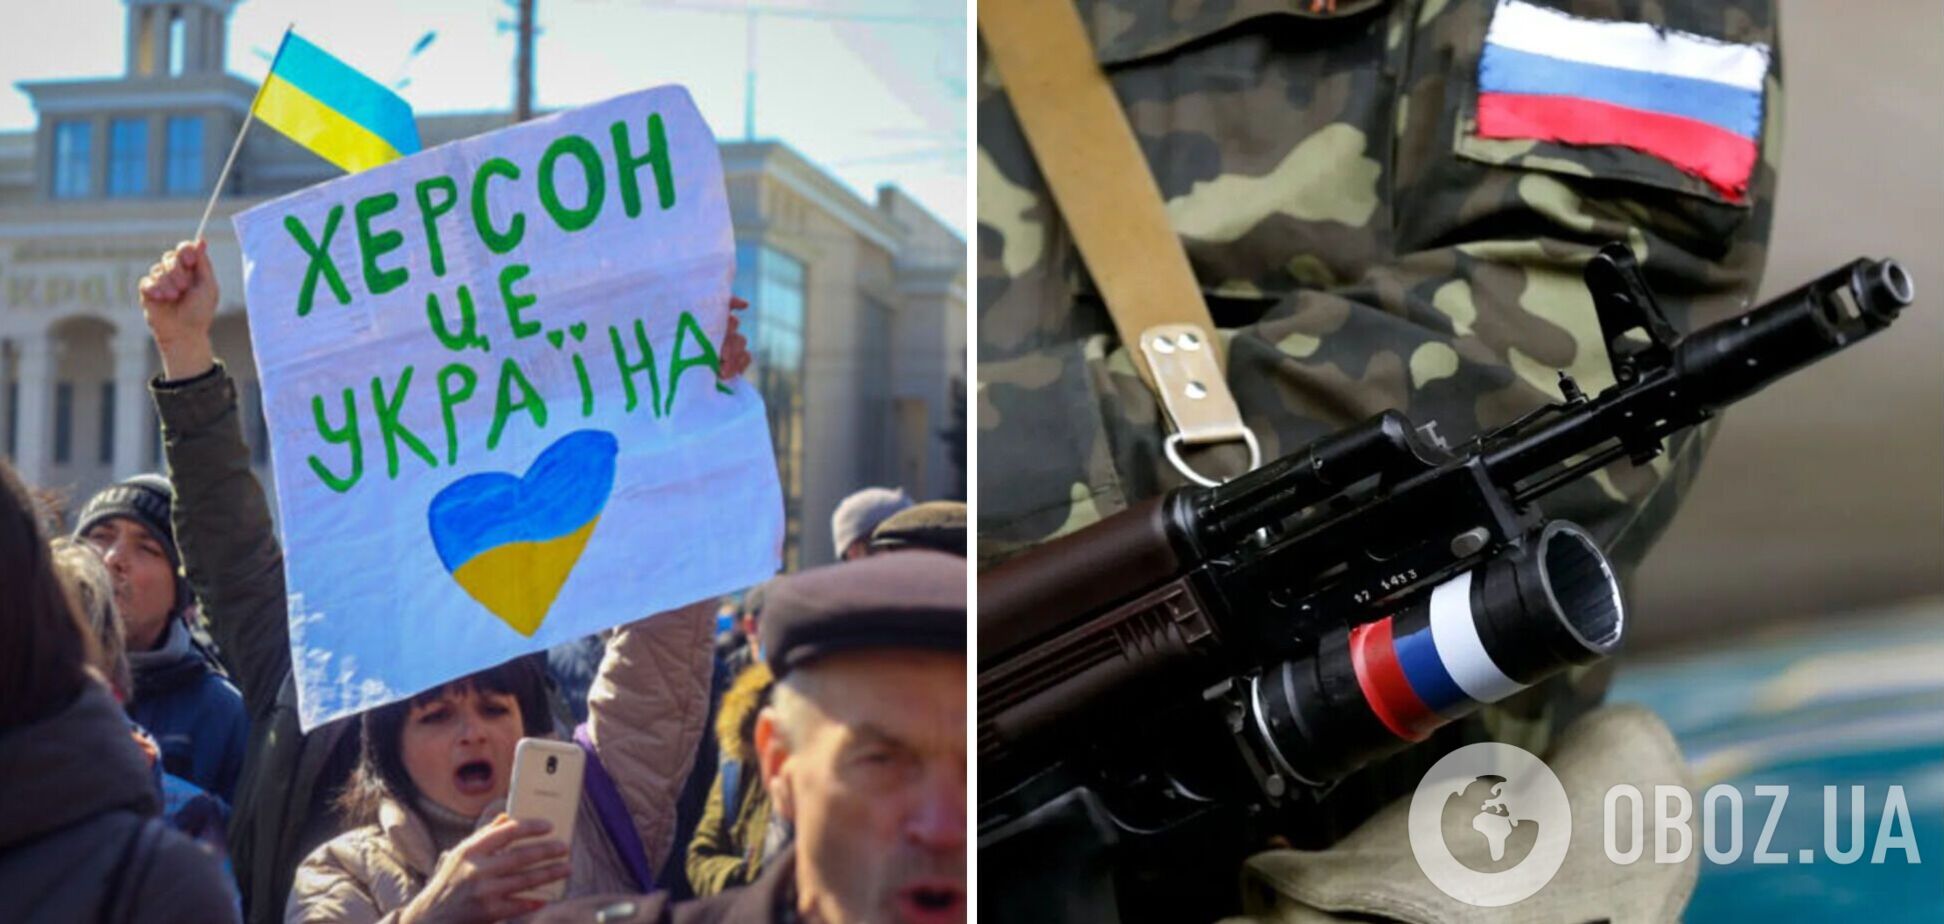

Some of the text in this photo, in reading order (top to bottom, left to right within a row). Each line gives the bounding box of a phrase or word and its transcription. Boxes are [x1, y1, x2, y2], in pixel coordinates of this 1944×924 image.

[284, 112, 675, 316] ХЕРСОН
[426, 264, 541, 352] ЦЕ
[308, 311, 734, 493] УКРАЇНА
